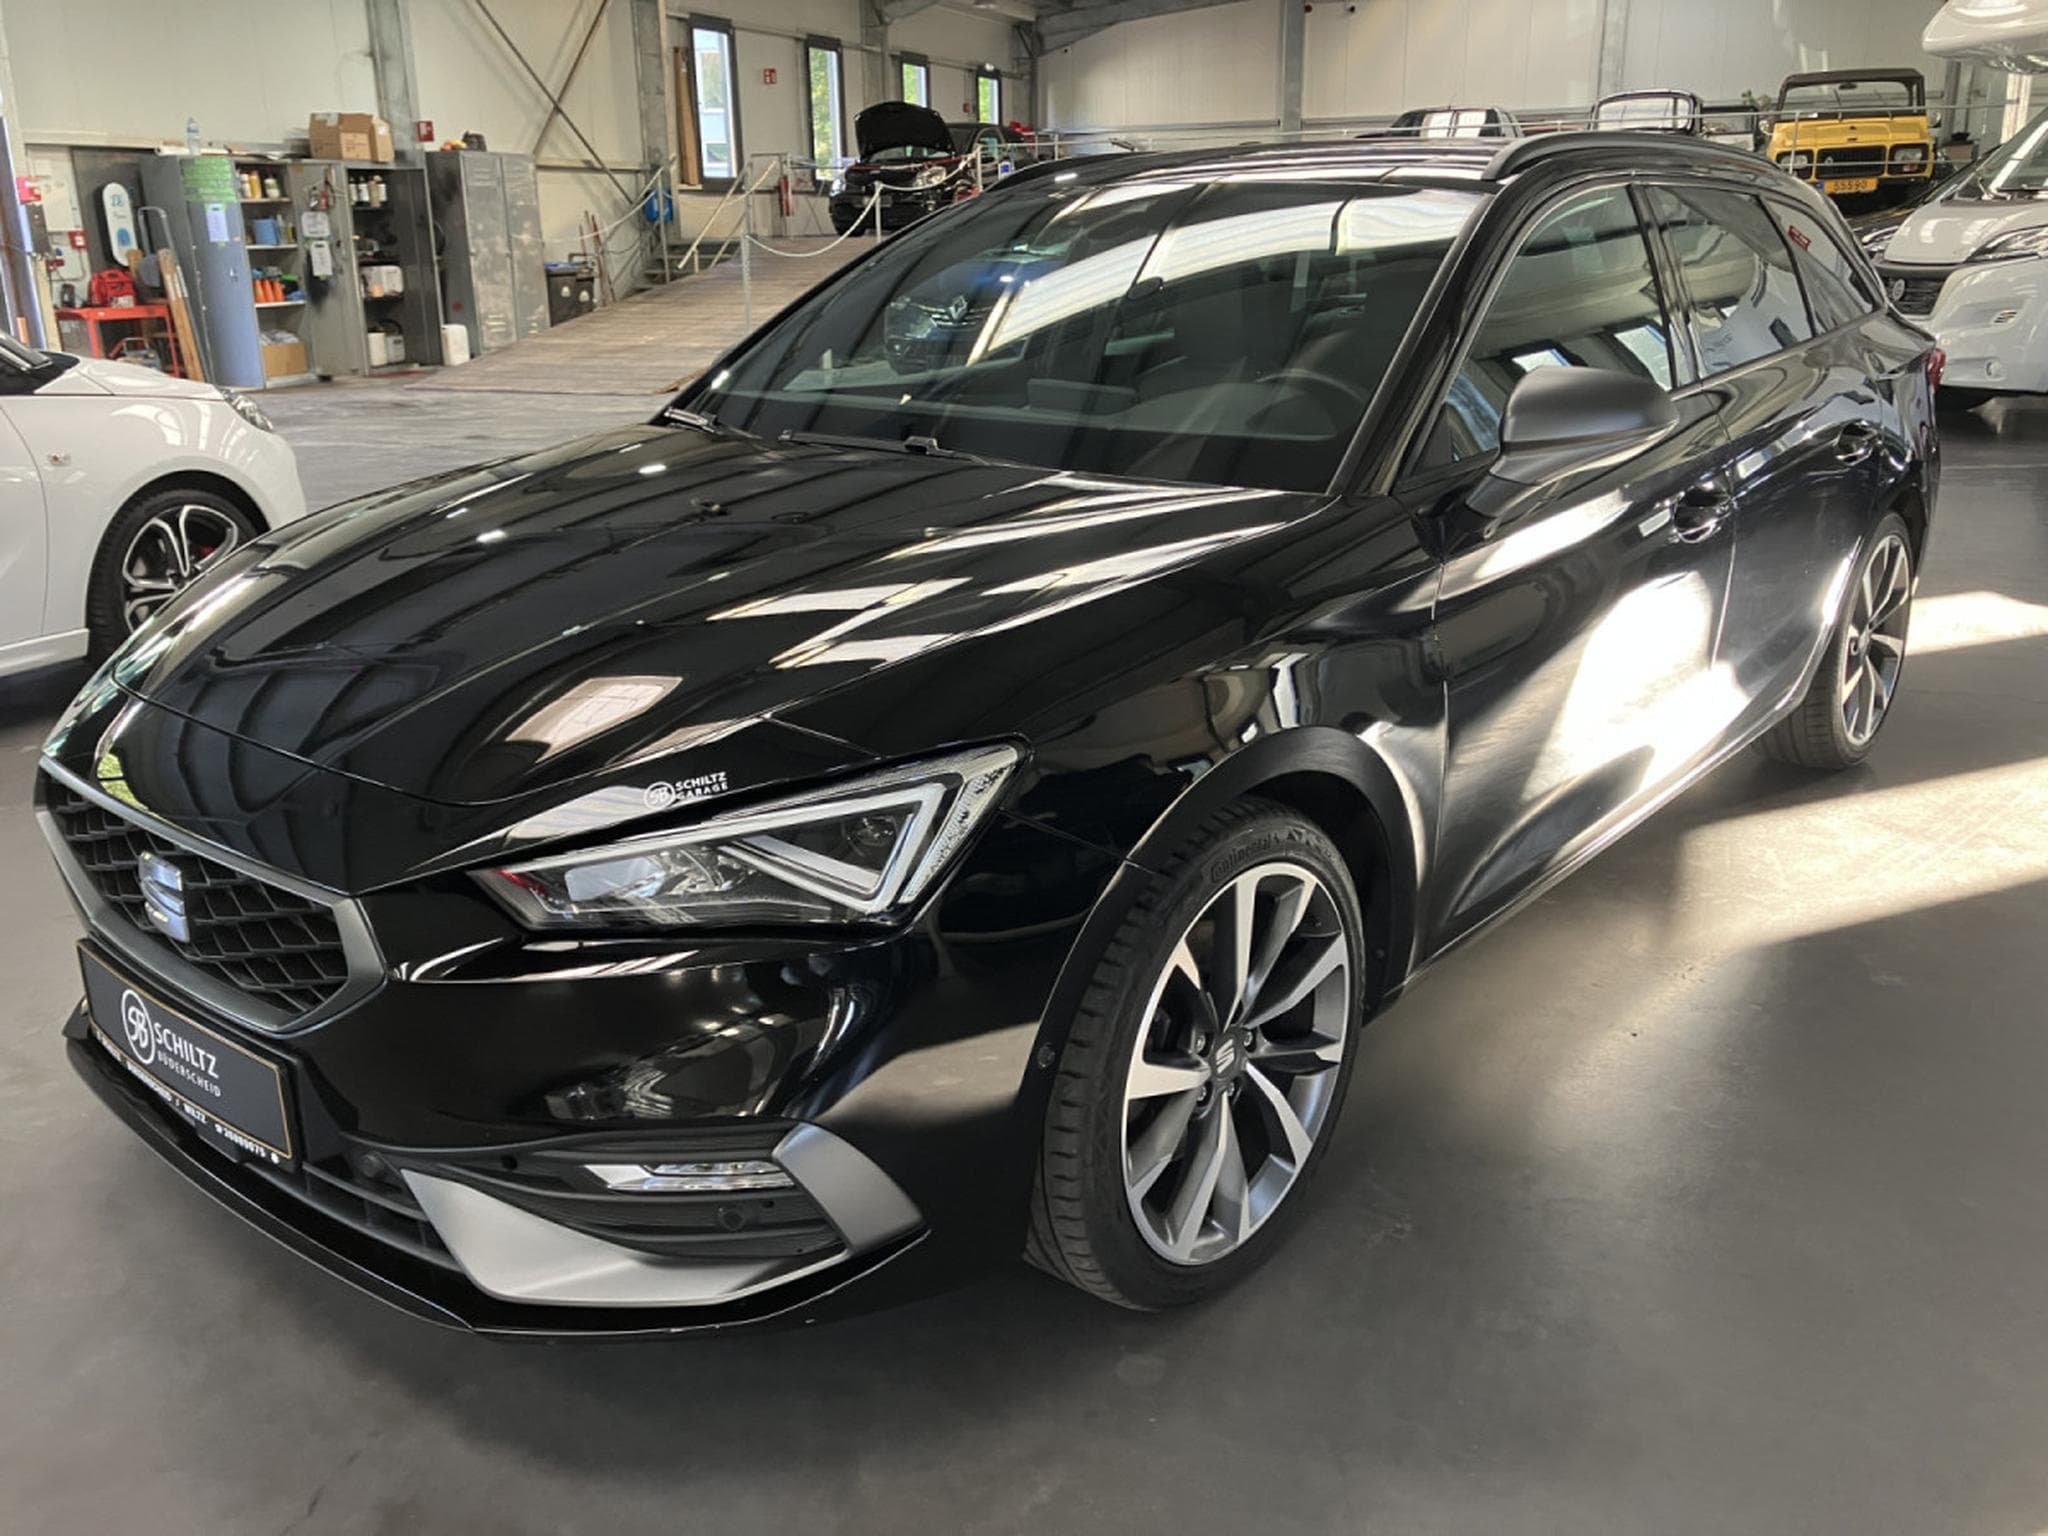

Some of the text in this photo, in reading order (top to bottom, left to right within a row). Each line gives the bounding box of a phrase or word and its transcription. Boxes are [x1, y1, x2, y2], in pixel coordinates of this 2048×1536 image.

[675, 771, 727, 791] SCHILTZ
[676, 781, 728, 800] GARAGE
[154, 1022, 219, 1079] SCHILTZ
